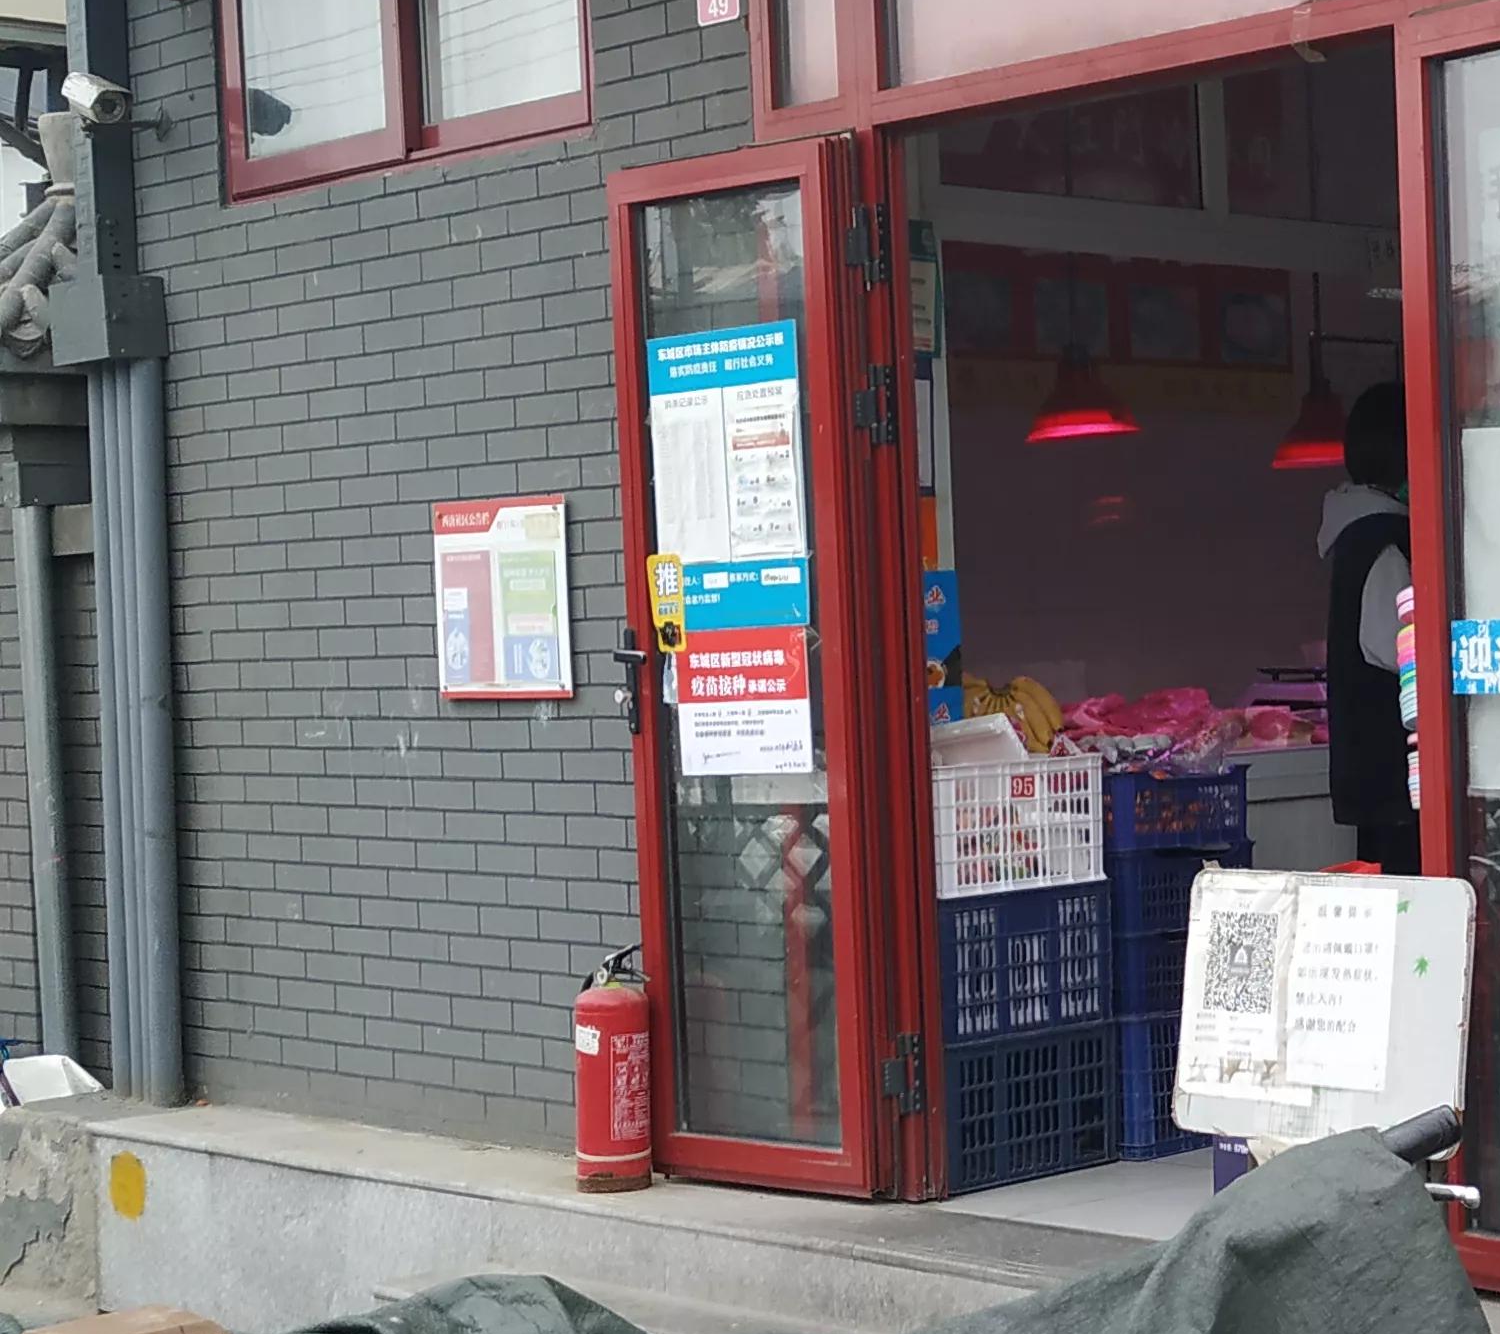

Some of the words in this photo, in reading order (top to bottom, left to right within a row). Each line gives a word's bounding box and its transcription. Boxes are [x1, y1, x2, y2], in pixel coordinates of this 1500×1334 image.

[654, 562, 679, 597] 推
[688, 649, 786, 669] 东城区新型冠状病毒
[1012, 776, 1034, 796] 95
